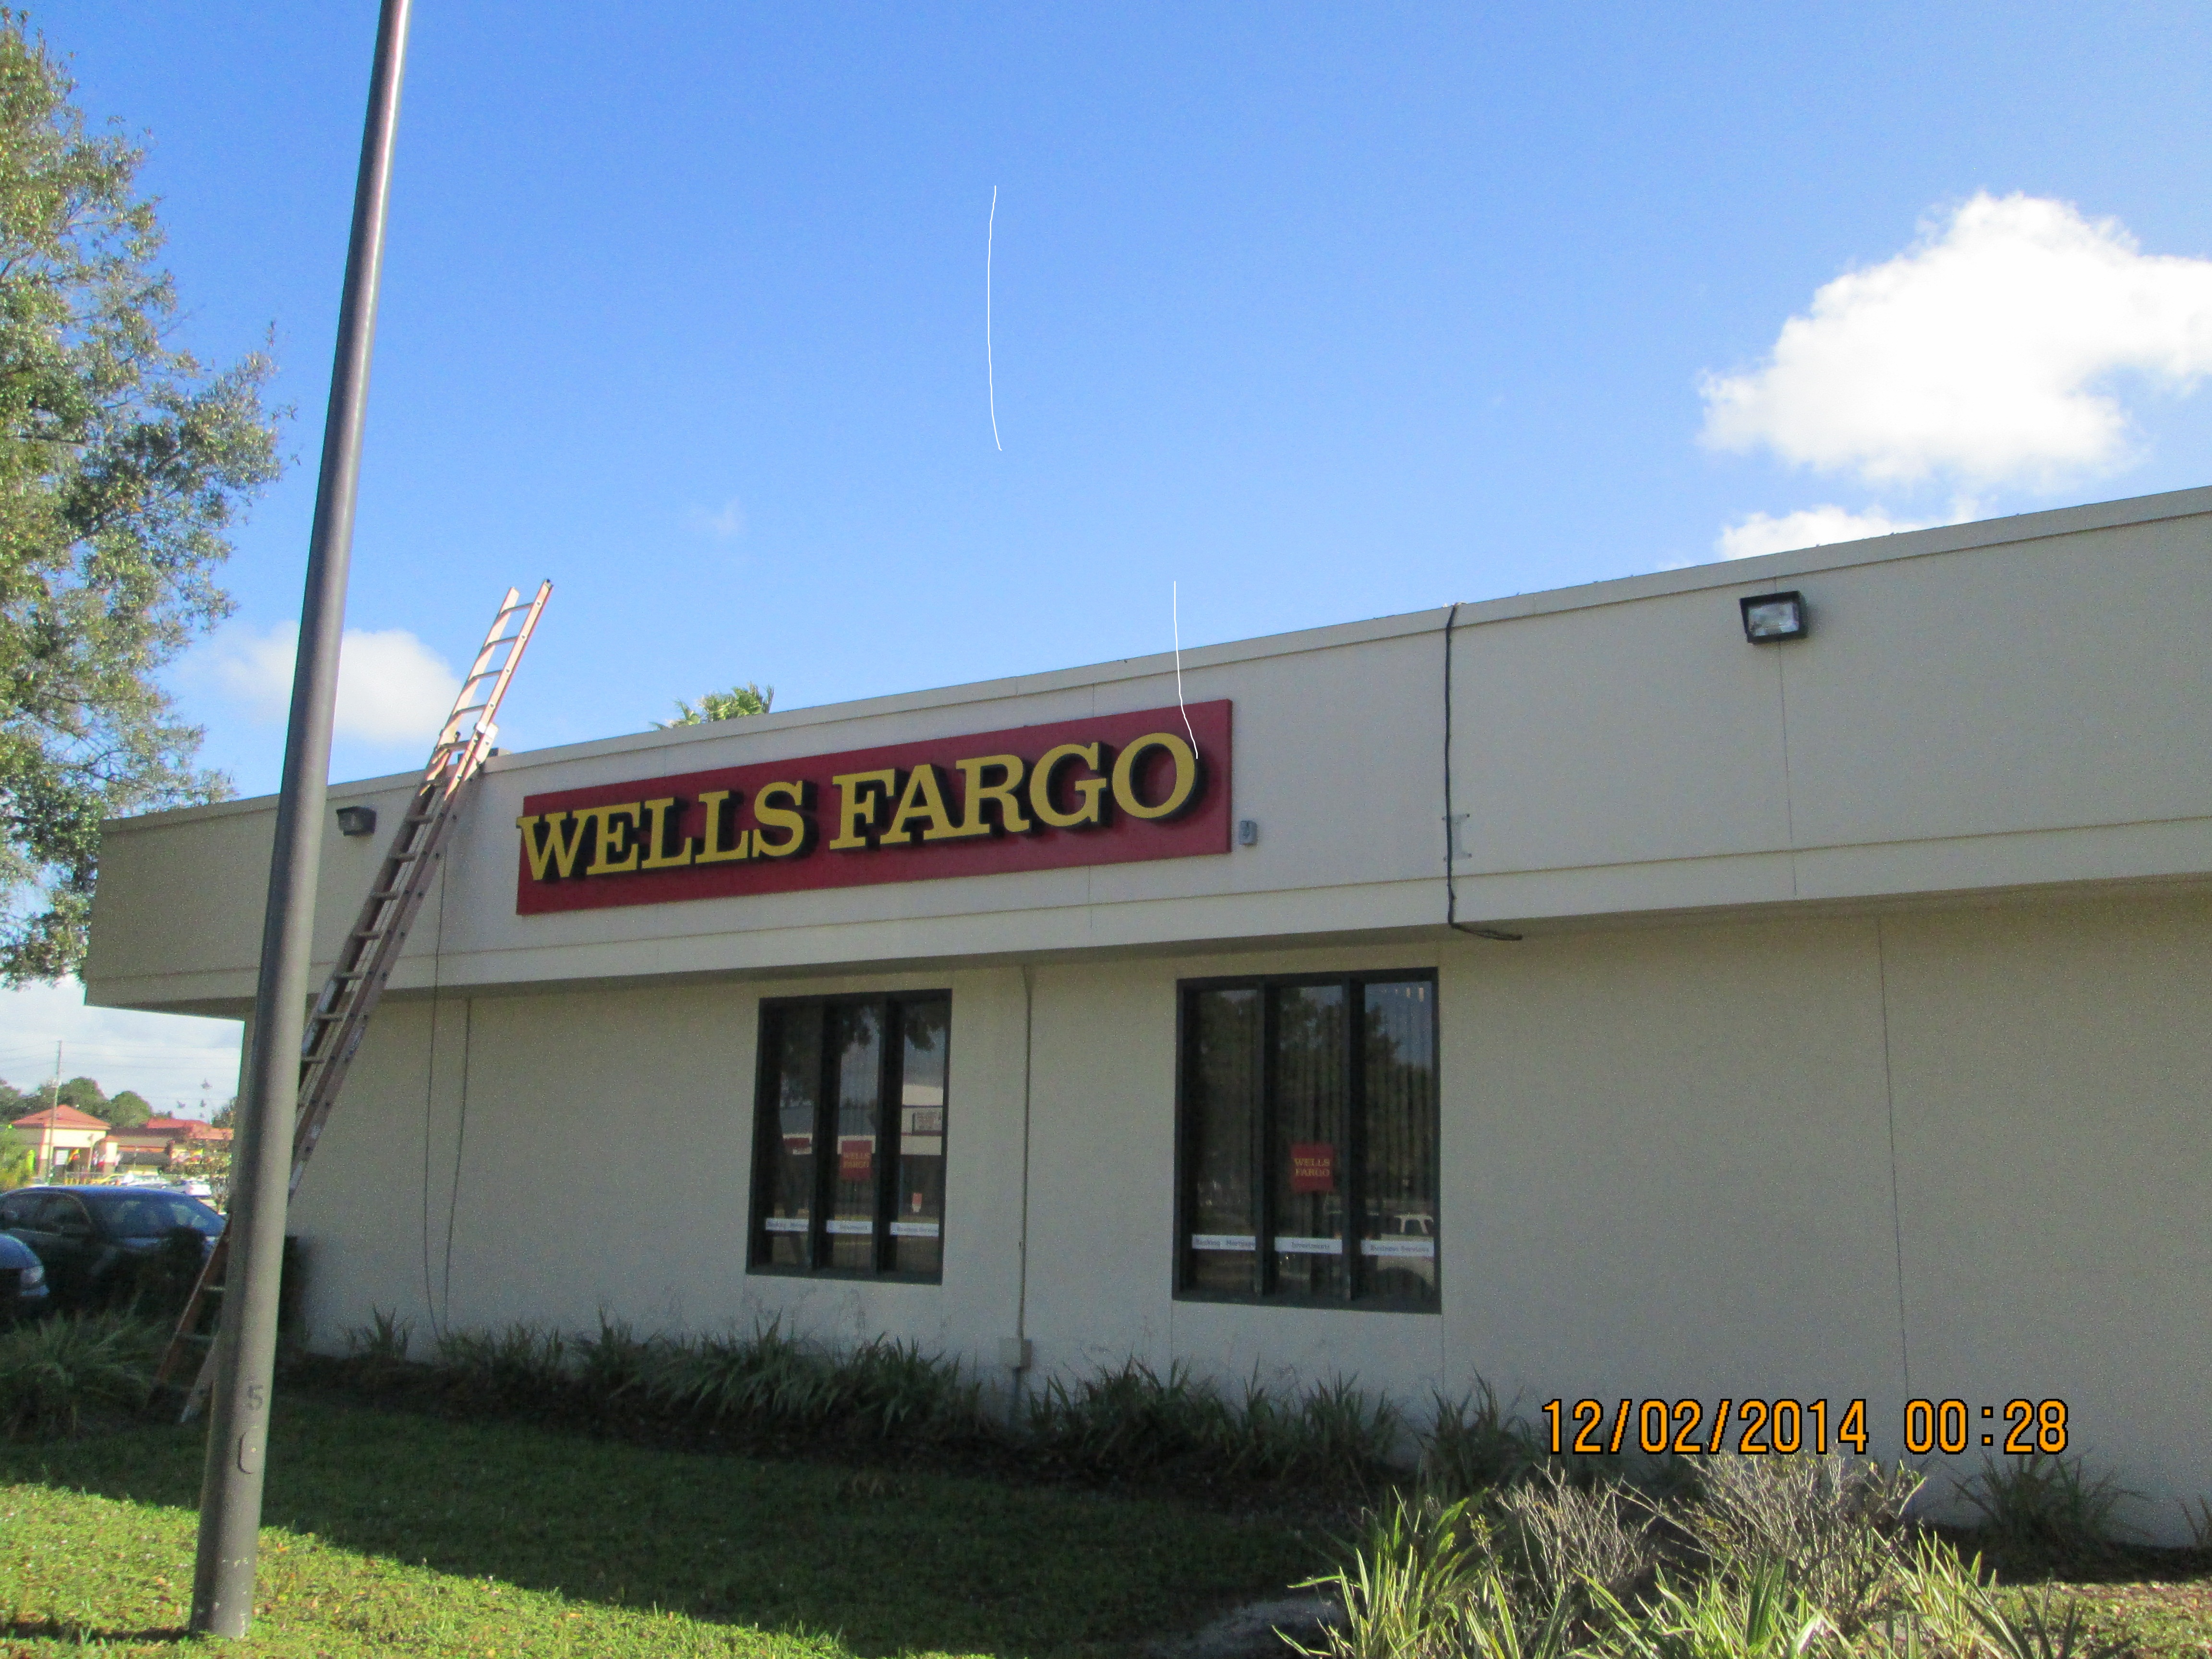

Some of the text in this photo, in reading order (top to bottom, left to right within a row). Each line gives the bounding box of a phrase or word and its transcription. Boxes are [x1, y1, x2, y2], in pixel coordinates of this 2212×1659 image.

[516, 732, 1198, 880] WELLS FARGO
[1294, 1157, 1331, 1167] WELLS
[1295, 1167, 1331, 1177] FARGO
[247, 1384, 264, 1410] 5
